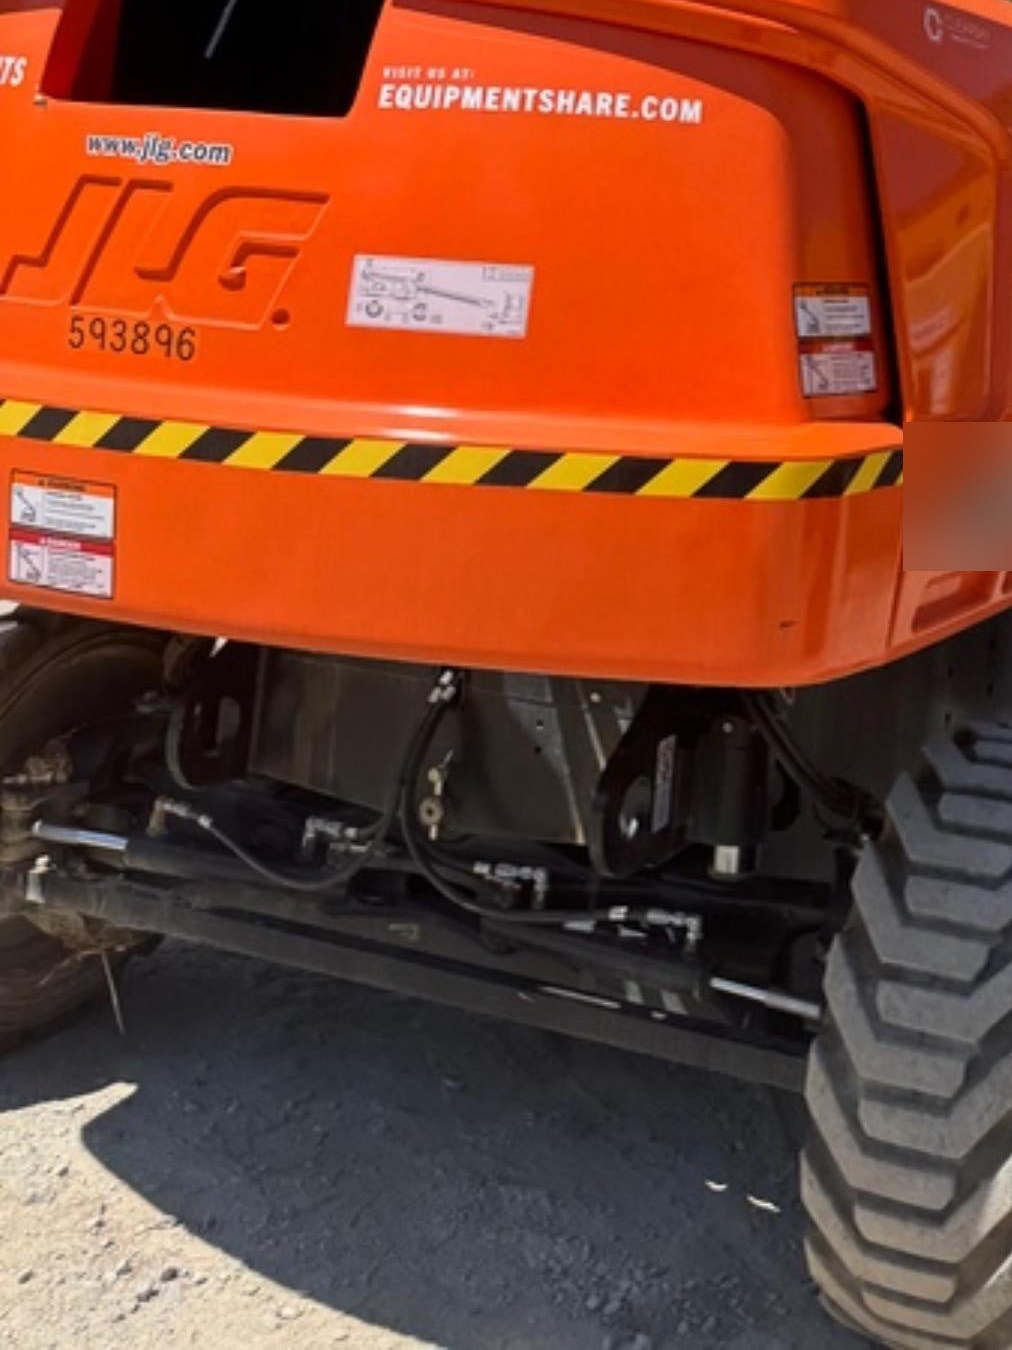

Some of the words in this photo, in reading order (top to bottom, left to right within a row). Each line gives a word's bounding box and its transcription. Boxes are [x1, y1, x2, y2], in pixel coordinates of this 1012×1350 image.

[378, 83, 703, 124] EQUIPMENTSHARE.COM
[86, 133, 233, 164] www.jlg.com
[68, 315, 197, 362] 593896
